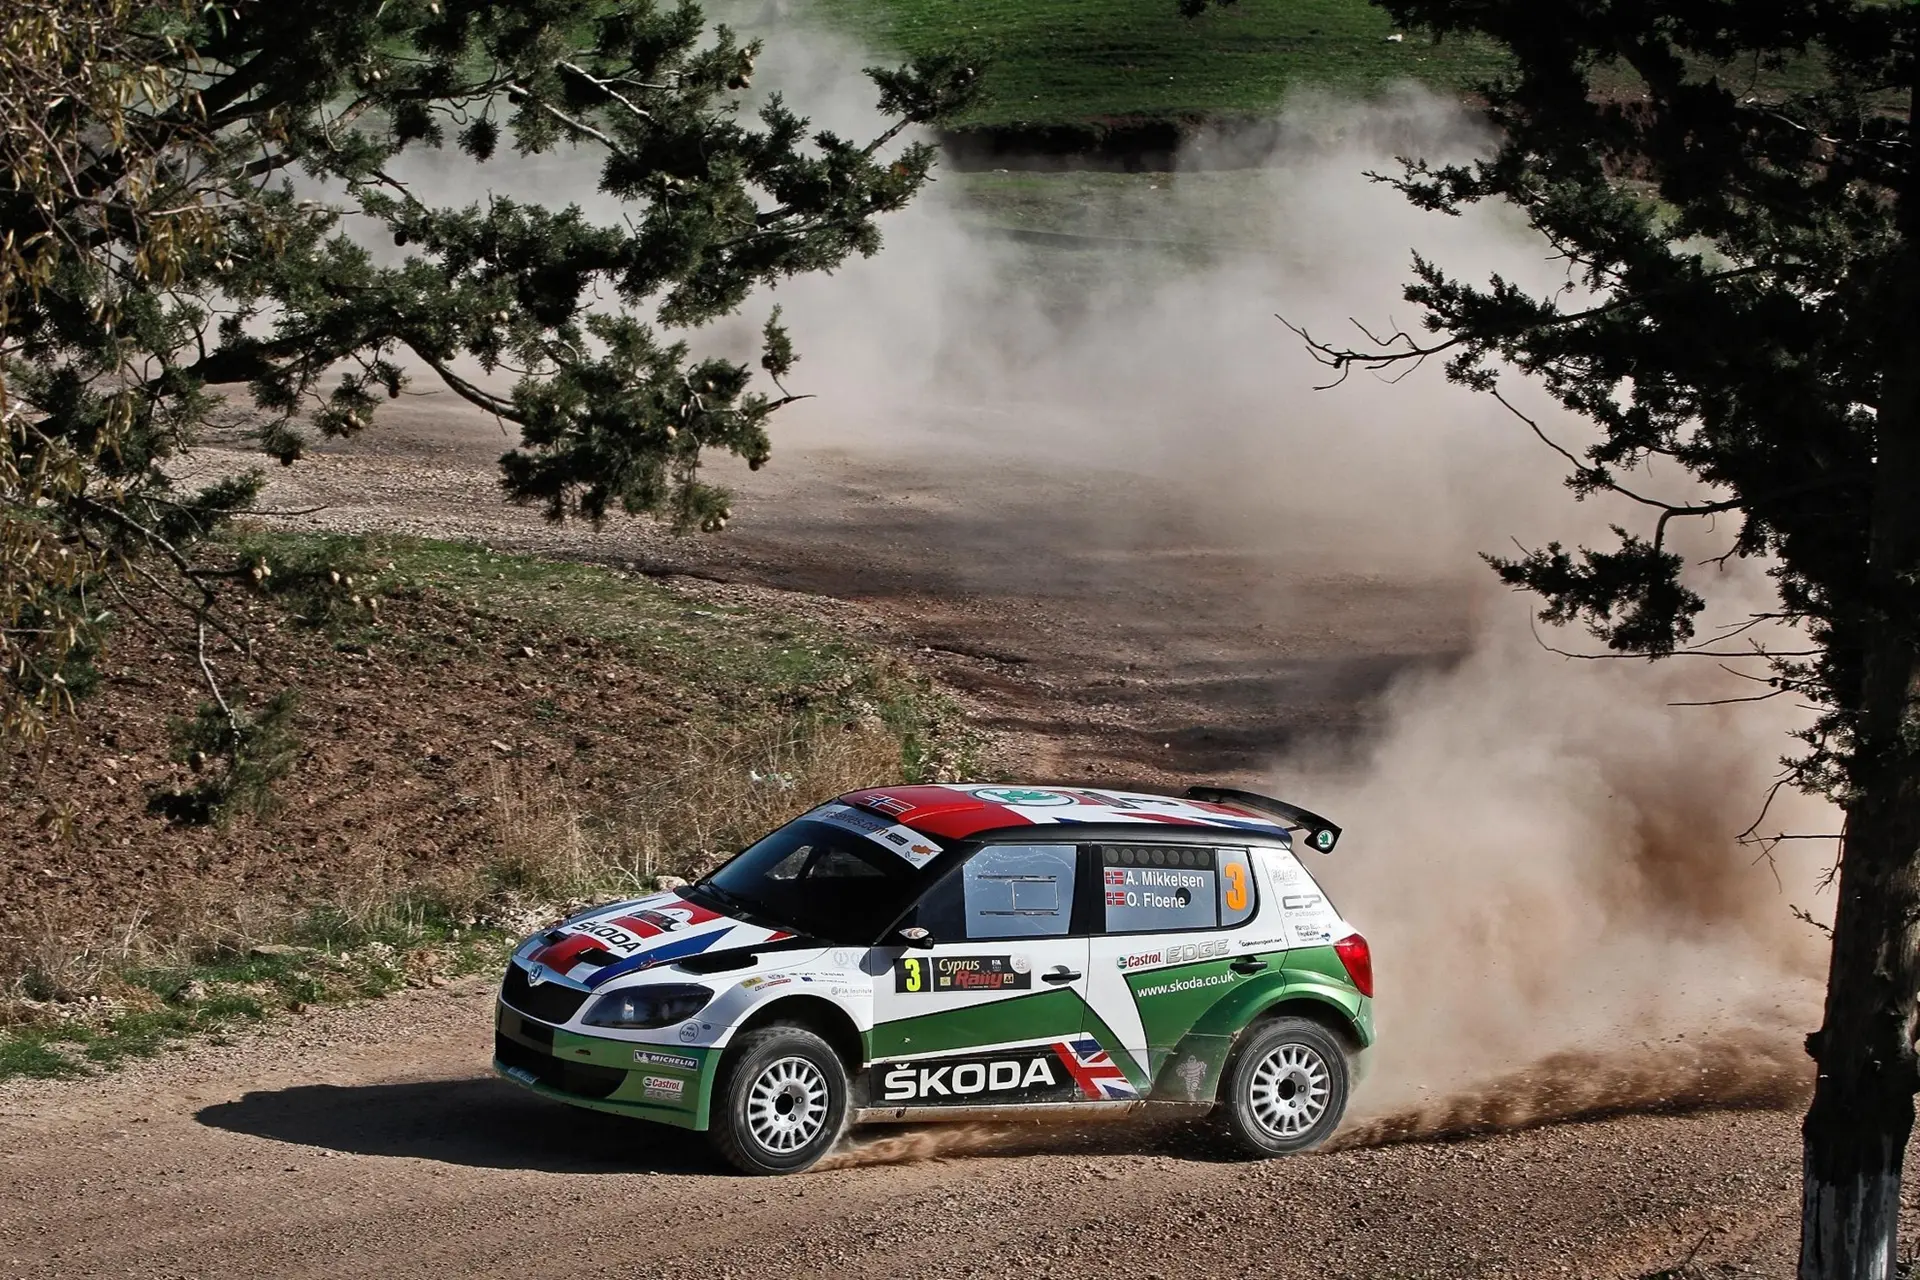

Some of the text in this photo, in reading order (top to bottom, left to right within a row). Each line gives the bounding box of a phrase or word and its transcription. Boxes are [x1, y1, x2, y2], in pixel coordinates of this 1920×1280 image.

[1125, 871, 1205, 888] A. Mikkelsen
[1224, 862, 1248, 912] 3
[1126, 892, 1186, 908] O. Floene
[571, 921, 642, 953] ŠKODA
[1128, 938, 1231, 969] Castrol EDGE
[904, 957, 922, 993] 3
[939, 958, 980, 976] Cyprus
[955, 970, 1004, 989] Rally
[1137, 971, 1236, 998] www.skoda.co.uk
[650, 1054, 696, 1068] MICHELIN
[652, 1078, 681, 1091] Castrol
[884, 1057, 1057, 1101] ŠKODA
